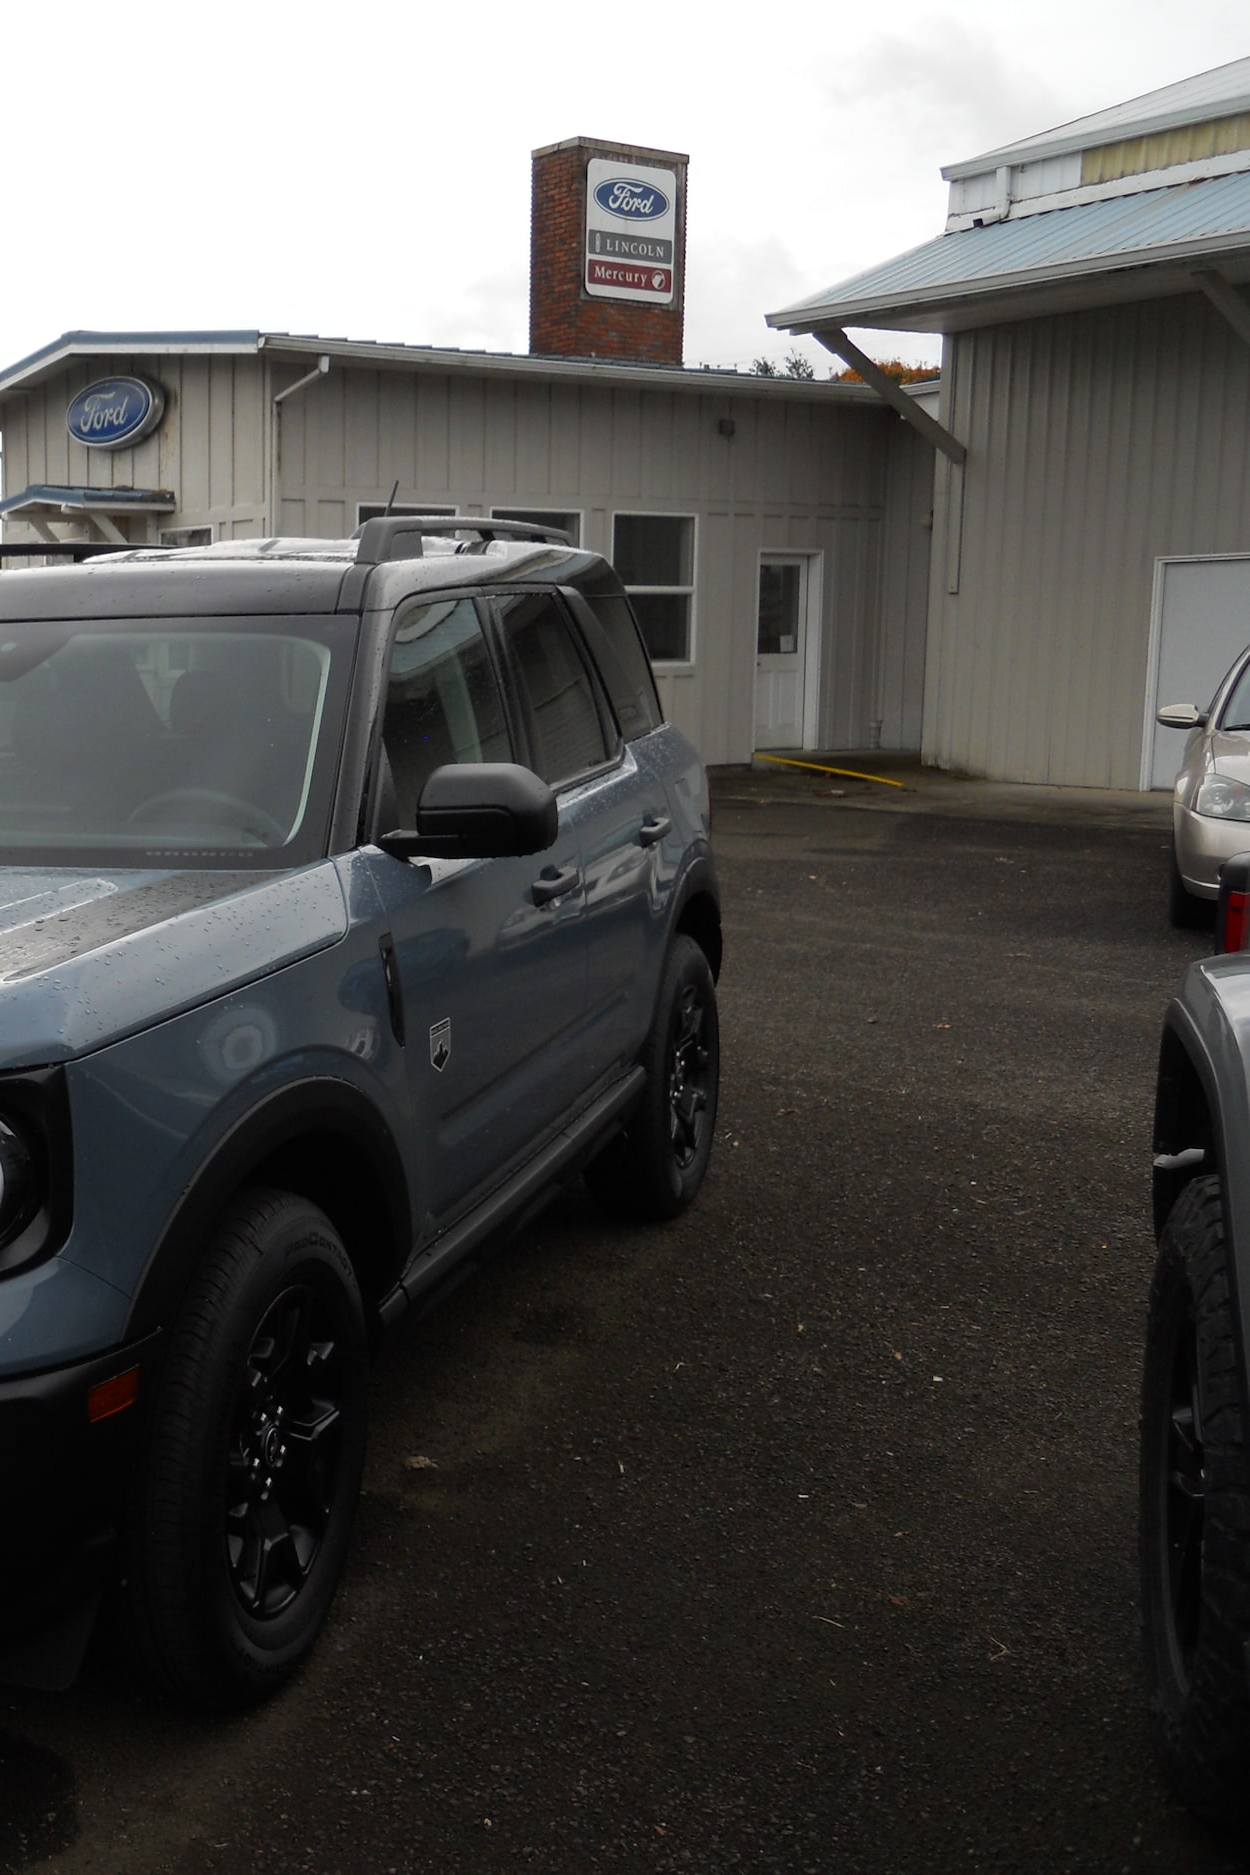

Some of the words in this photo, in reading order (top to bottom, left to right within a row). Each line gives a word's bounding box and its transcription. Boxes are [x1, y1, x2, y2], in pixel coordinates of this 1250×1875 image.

[608, 182, 654, 214] Ford
[606, 238, 664, 257] LINCOLN
[594, 265, 648, 287] Mercury
[80, 391, 129, 433] Ford
